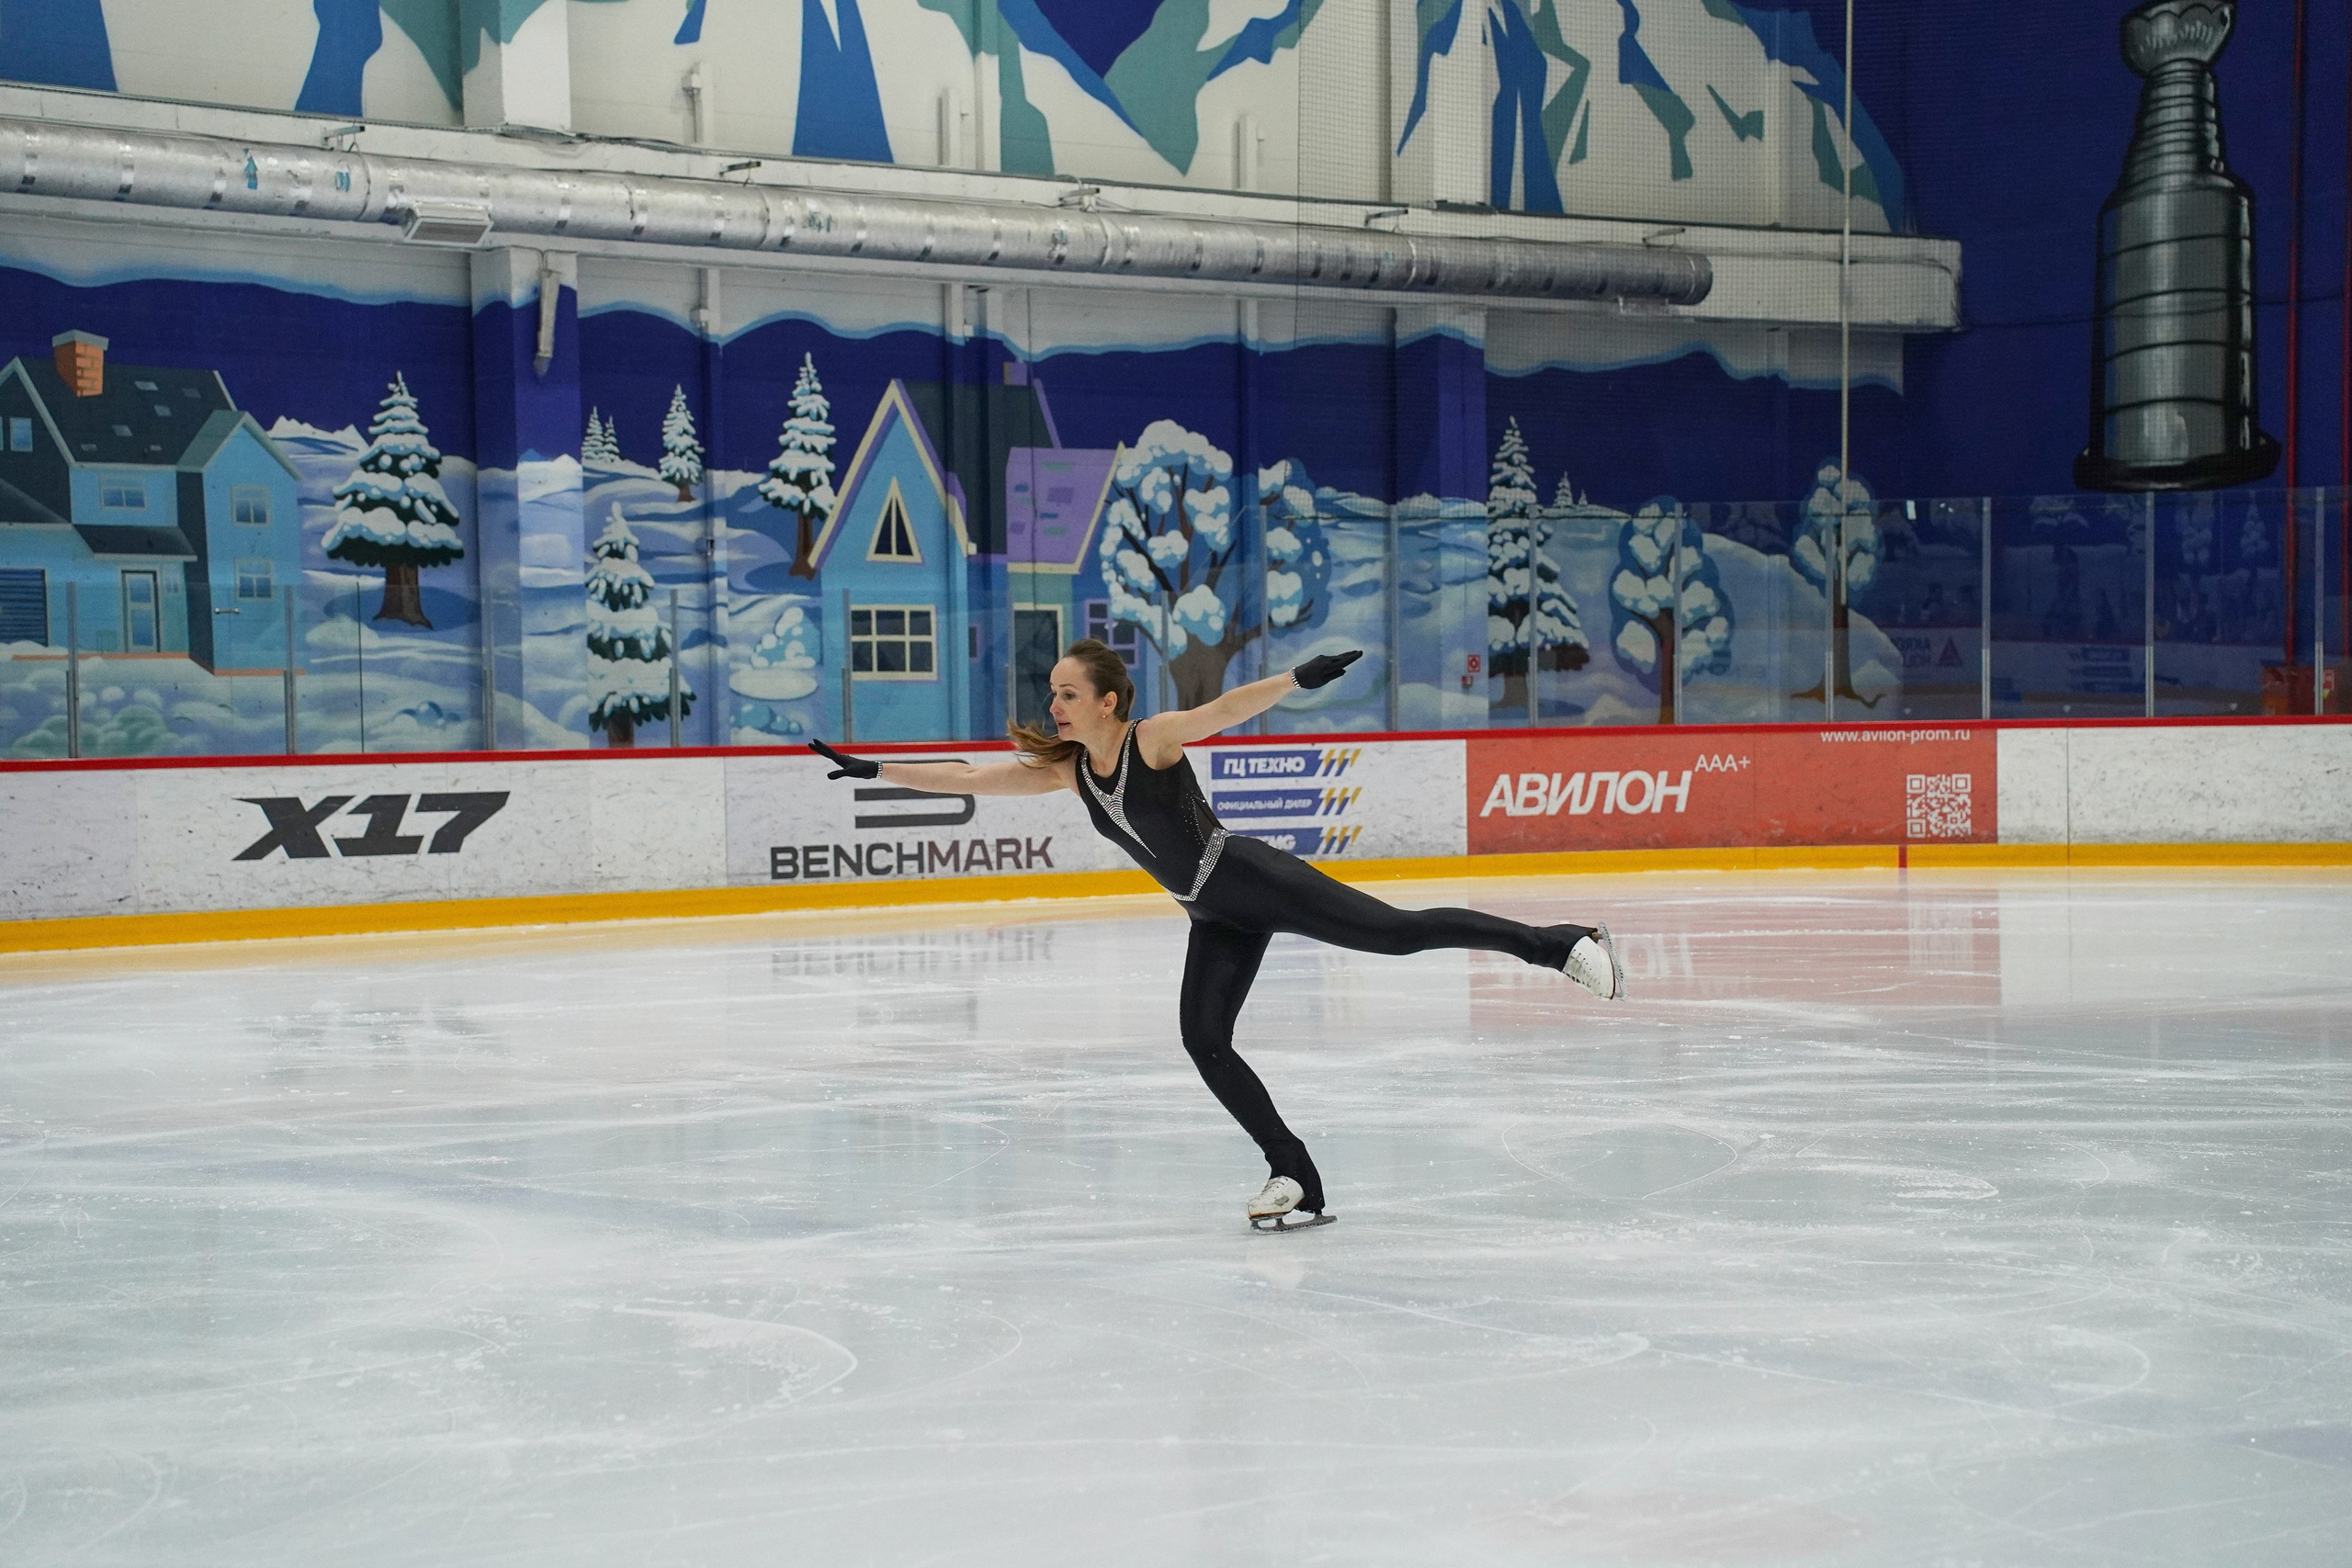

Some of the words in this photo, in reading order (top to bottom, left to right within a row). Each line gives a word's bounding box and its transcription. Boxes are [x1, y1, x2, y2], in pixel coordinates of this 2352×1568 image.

[1820, 728, 1971, 744] www.avilon-prom.ru
[1223, 757, 1246, 776] ГЦ
[1248, 756, 1306, 774] ТЕХНО
[1217, 797, 1283, 812] ОФИЦИАЛЬНЫЙ
[1283, 798, 1313, 810] ДИЛЕР
[1479, 770, 1692, 817] АВИЛОН
[232, 791, 511, 861] X17
[770, 836, 1055, 879] BENCHMARK
